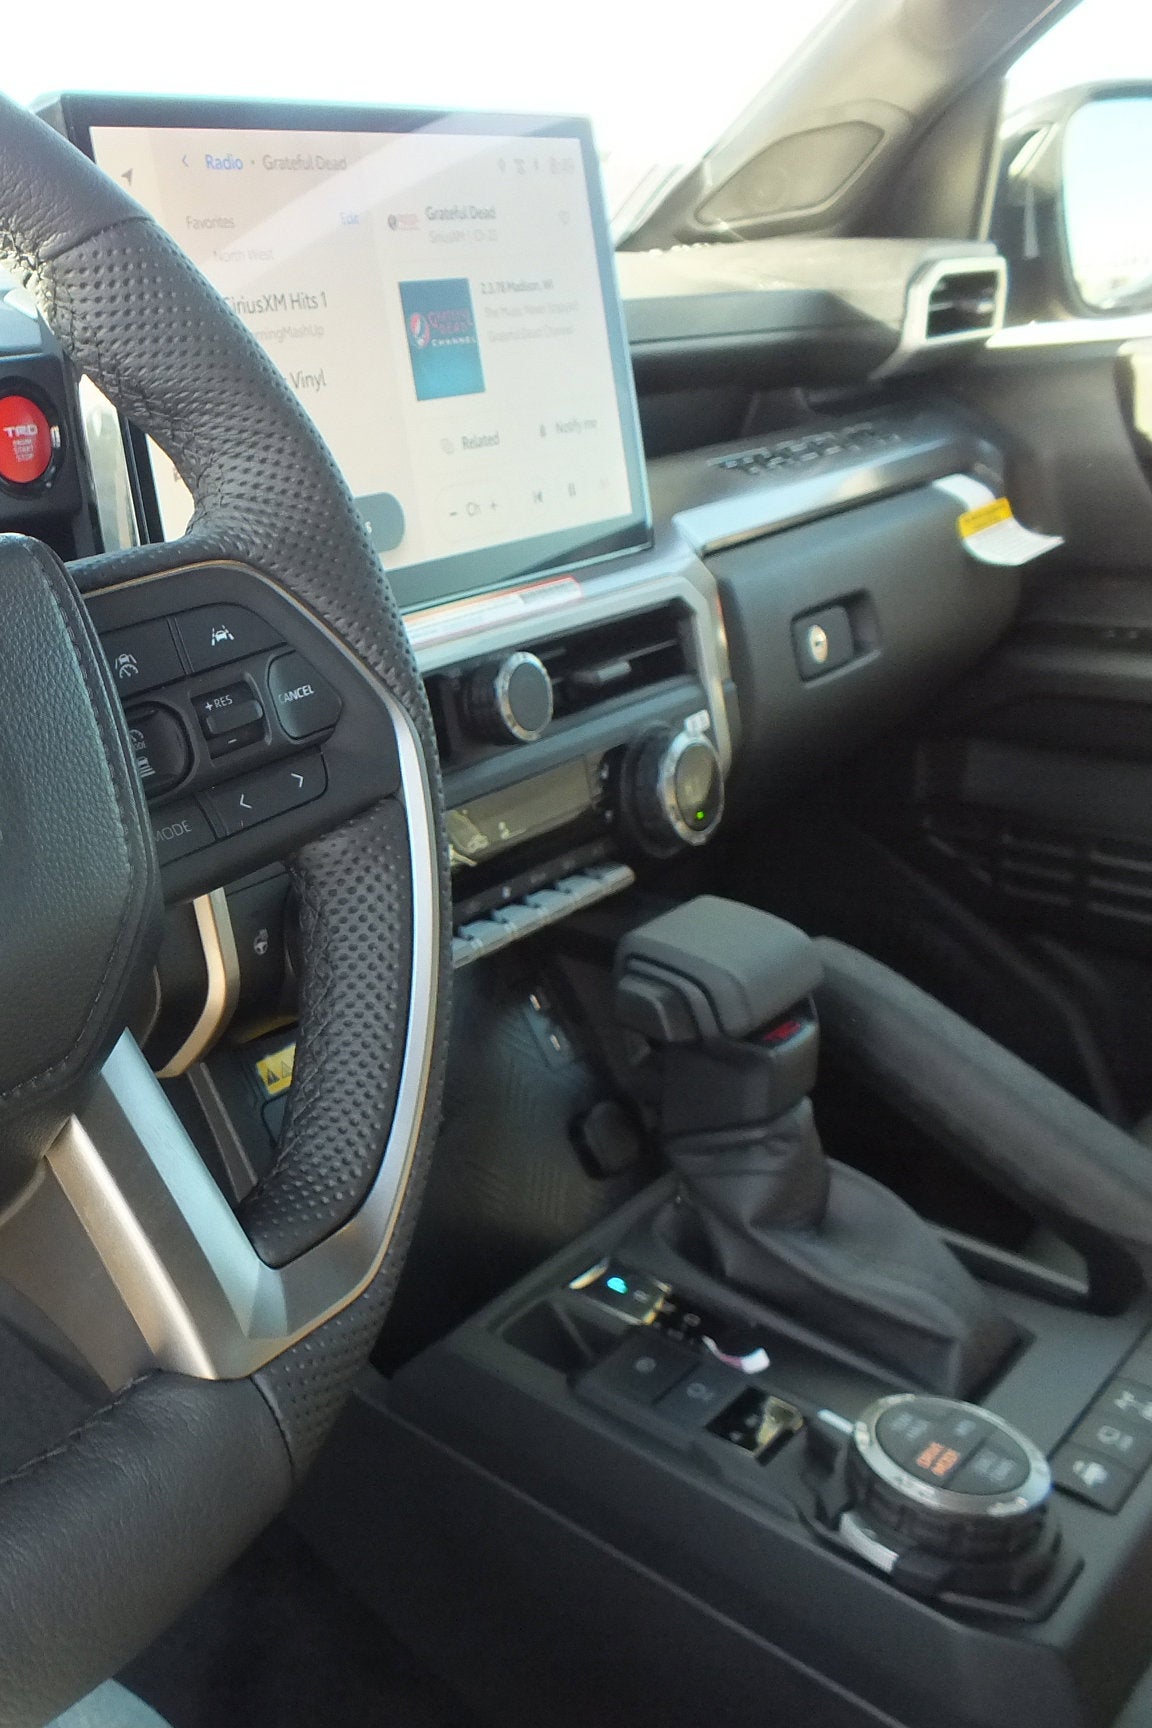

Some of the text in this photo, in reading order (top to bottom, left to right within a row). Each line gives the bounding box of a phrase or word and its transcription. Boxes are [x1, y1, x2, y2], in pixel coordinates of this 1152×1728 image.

[205, 154, 346, 170] Radio Grateful Dead
[425, 204, 496, 220] Grateful Dead
[185, 215, 236, 229] Favorites
[288, 291, 319, 311] Hits
[319, 288, 328, 309] 1
[289, 368, 328, 392] Vinyl
[3, 423, 38, 438] TRD
[461, 428, 500, 450] Related
[278, 684, 315, 704] CANCEL
